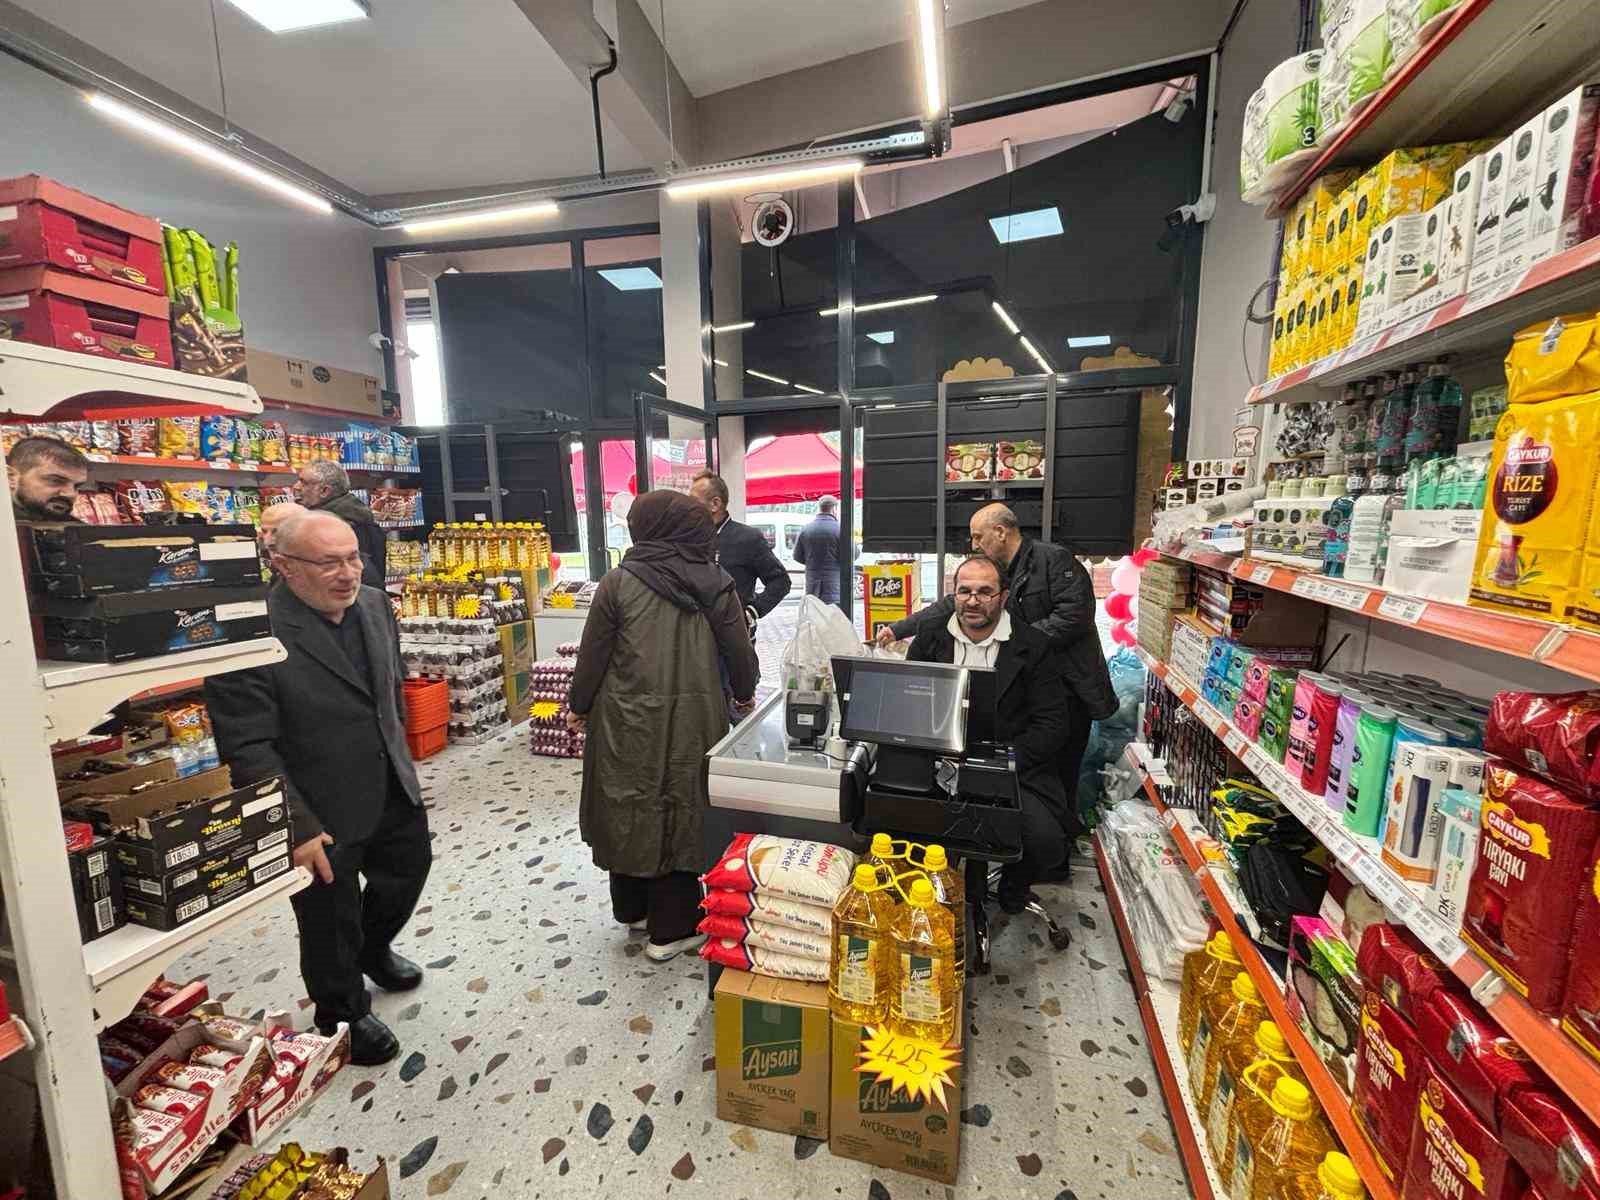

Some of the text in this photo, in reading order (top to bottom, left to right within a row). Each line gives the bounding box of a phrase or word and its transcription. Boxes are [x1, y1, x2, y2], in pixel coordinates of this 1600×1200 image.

[1303, 126, 1316, 146] 3
[1502, 472, 1544, 493] RİZE
[743, 1047, 799, 1077] Aysan
[171, 1113, 226, 1174] sarelle
